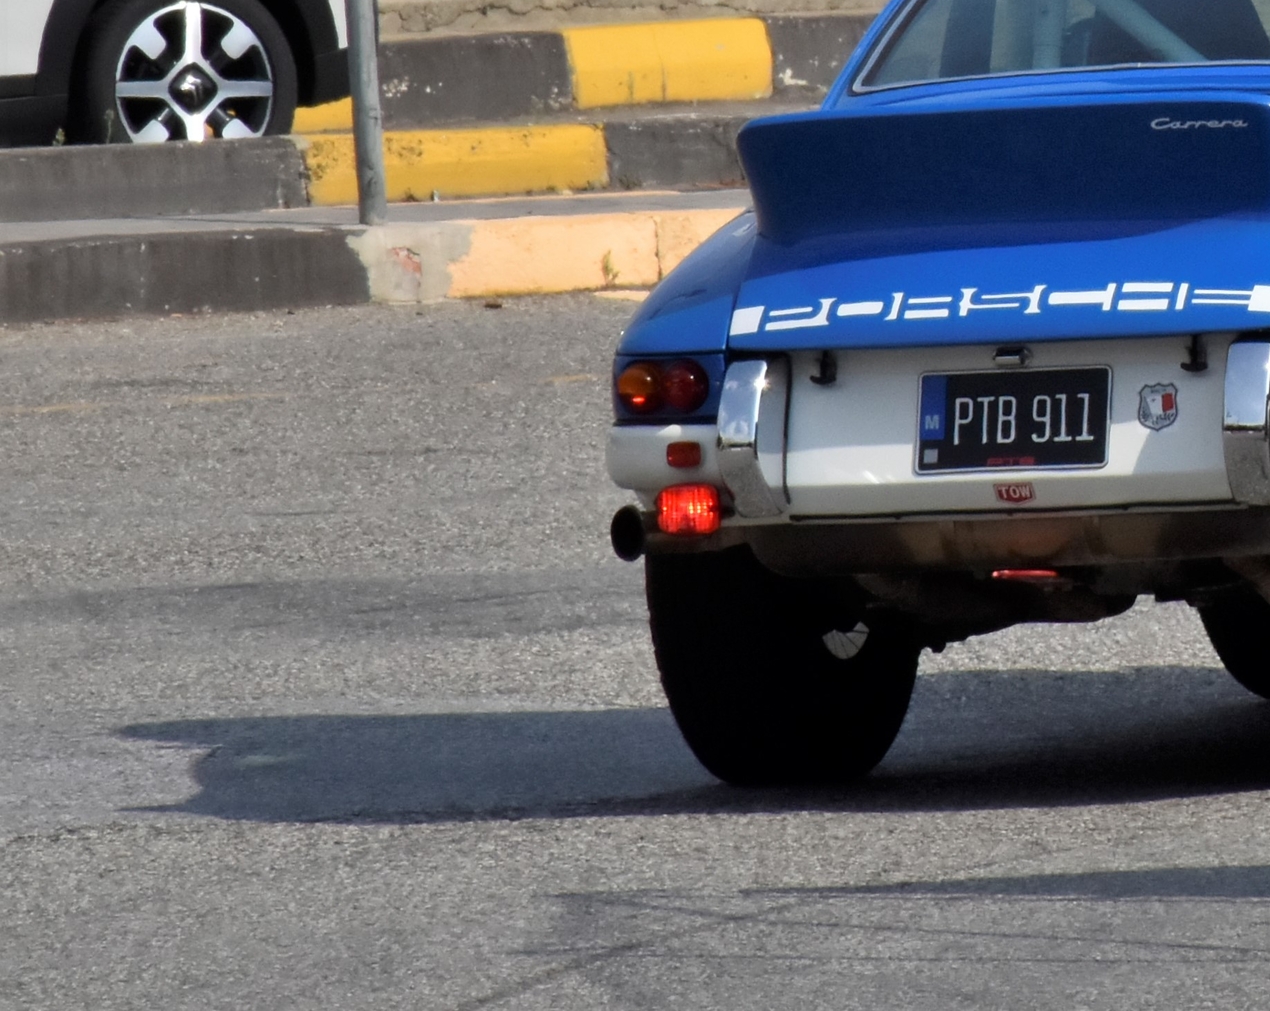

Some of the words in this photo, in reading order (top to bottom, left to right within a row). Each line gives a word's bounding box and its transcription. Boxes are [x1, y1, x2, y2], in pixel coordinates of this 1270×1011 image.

[1150, 117, 1248, 130] Carrera
[924, 414, 940, 430] M
[953, 395, 1018, 445] PTB
[1031, 393, 1094, 443] 911
[997, 485, 1032, 499] TOW
